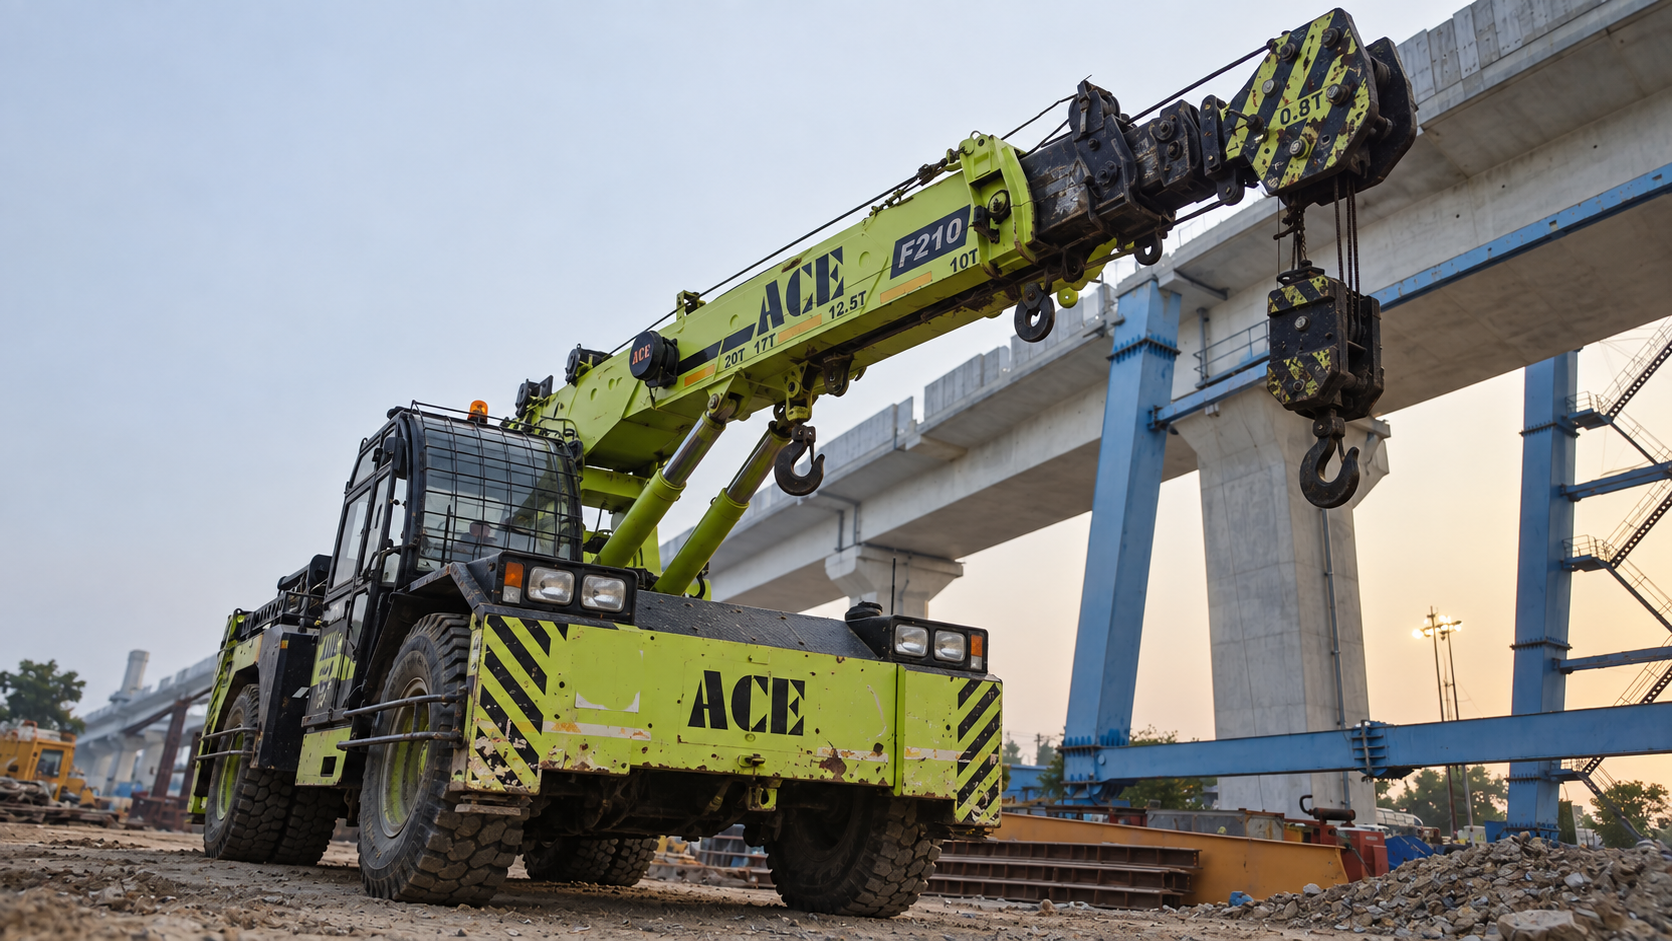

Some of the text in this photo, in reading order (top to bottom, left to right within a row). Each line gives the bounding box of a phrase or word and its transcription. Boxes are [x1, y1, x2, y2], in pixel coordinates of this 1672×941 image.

[1280, 91, 1324, 125] 0.8T
[897, 217, 963, 269] F210
[950, 248, 978, 273] 10T
[757, 246, 844, 336] ACE
[829, 290, 867, 319] 12.5T
[632, 343, 651, 365] ACE
[754, 333, 776, 354] 17T
[724, 348, 745, 369] 20T
[687, 670, 805, 736] ACE
